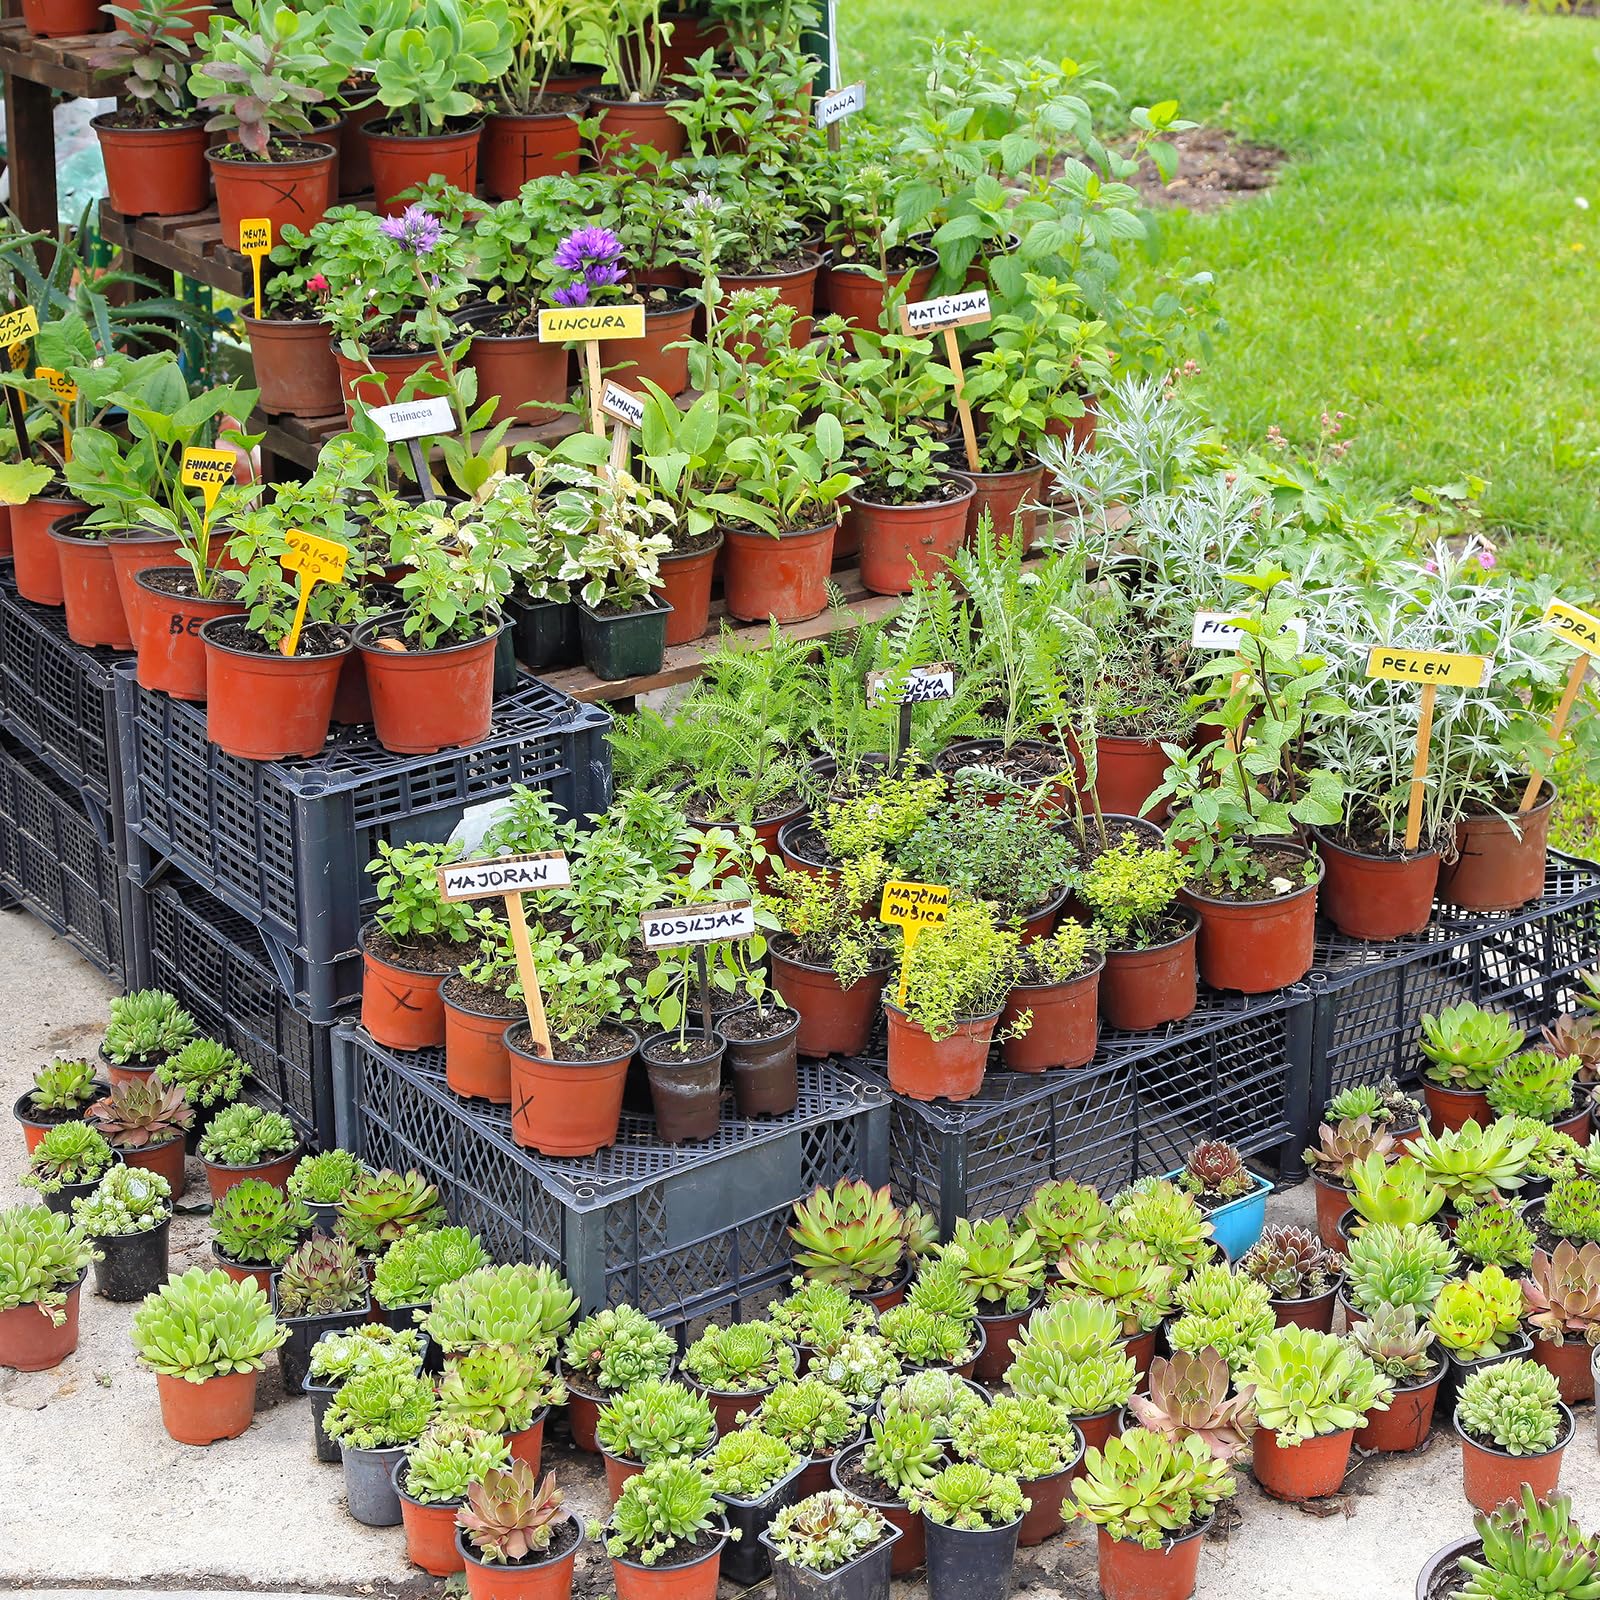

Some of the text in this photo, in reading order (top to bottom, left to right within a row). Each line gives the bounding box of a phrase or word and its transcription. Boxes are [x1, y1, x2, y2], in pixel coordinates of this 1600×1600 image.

[908, 298, 986, 321] MATIČNJAK
[548, 315, 626, 331] LINCURA
[185, 459, 233, 472] EHINACE
[193, 471, 225, 483] BELA
[1382, 657, 1451, 676] PELEN
[447, 865, 547, 889] MAJORAN
[889, 904, 946, 923] DUŠICA
[648, 912, 745, 937] BOSILJAK
